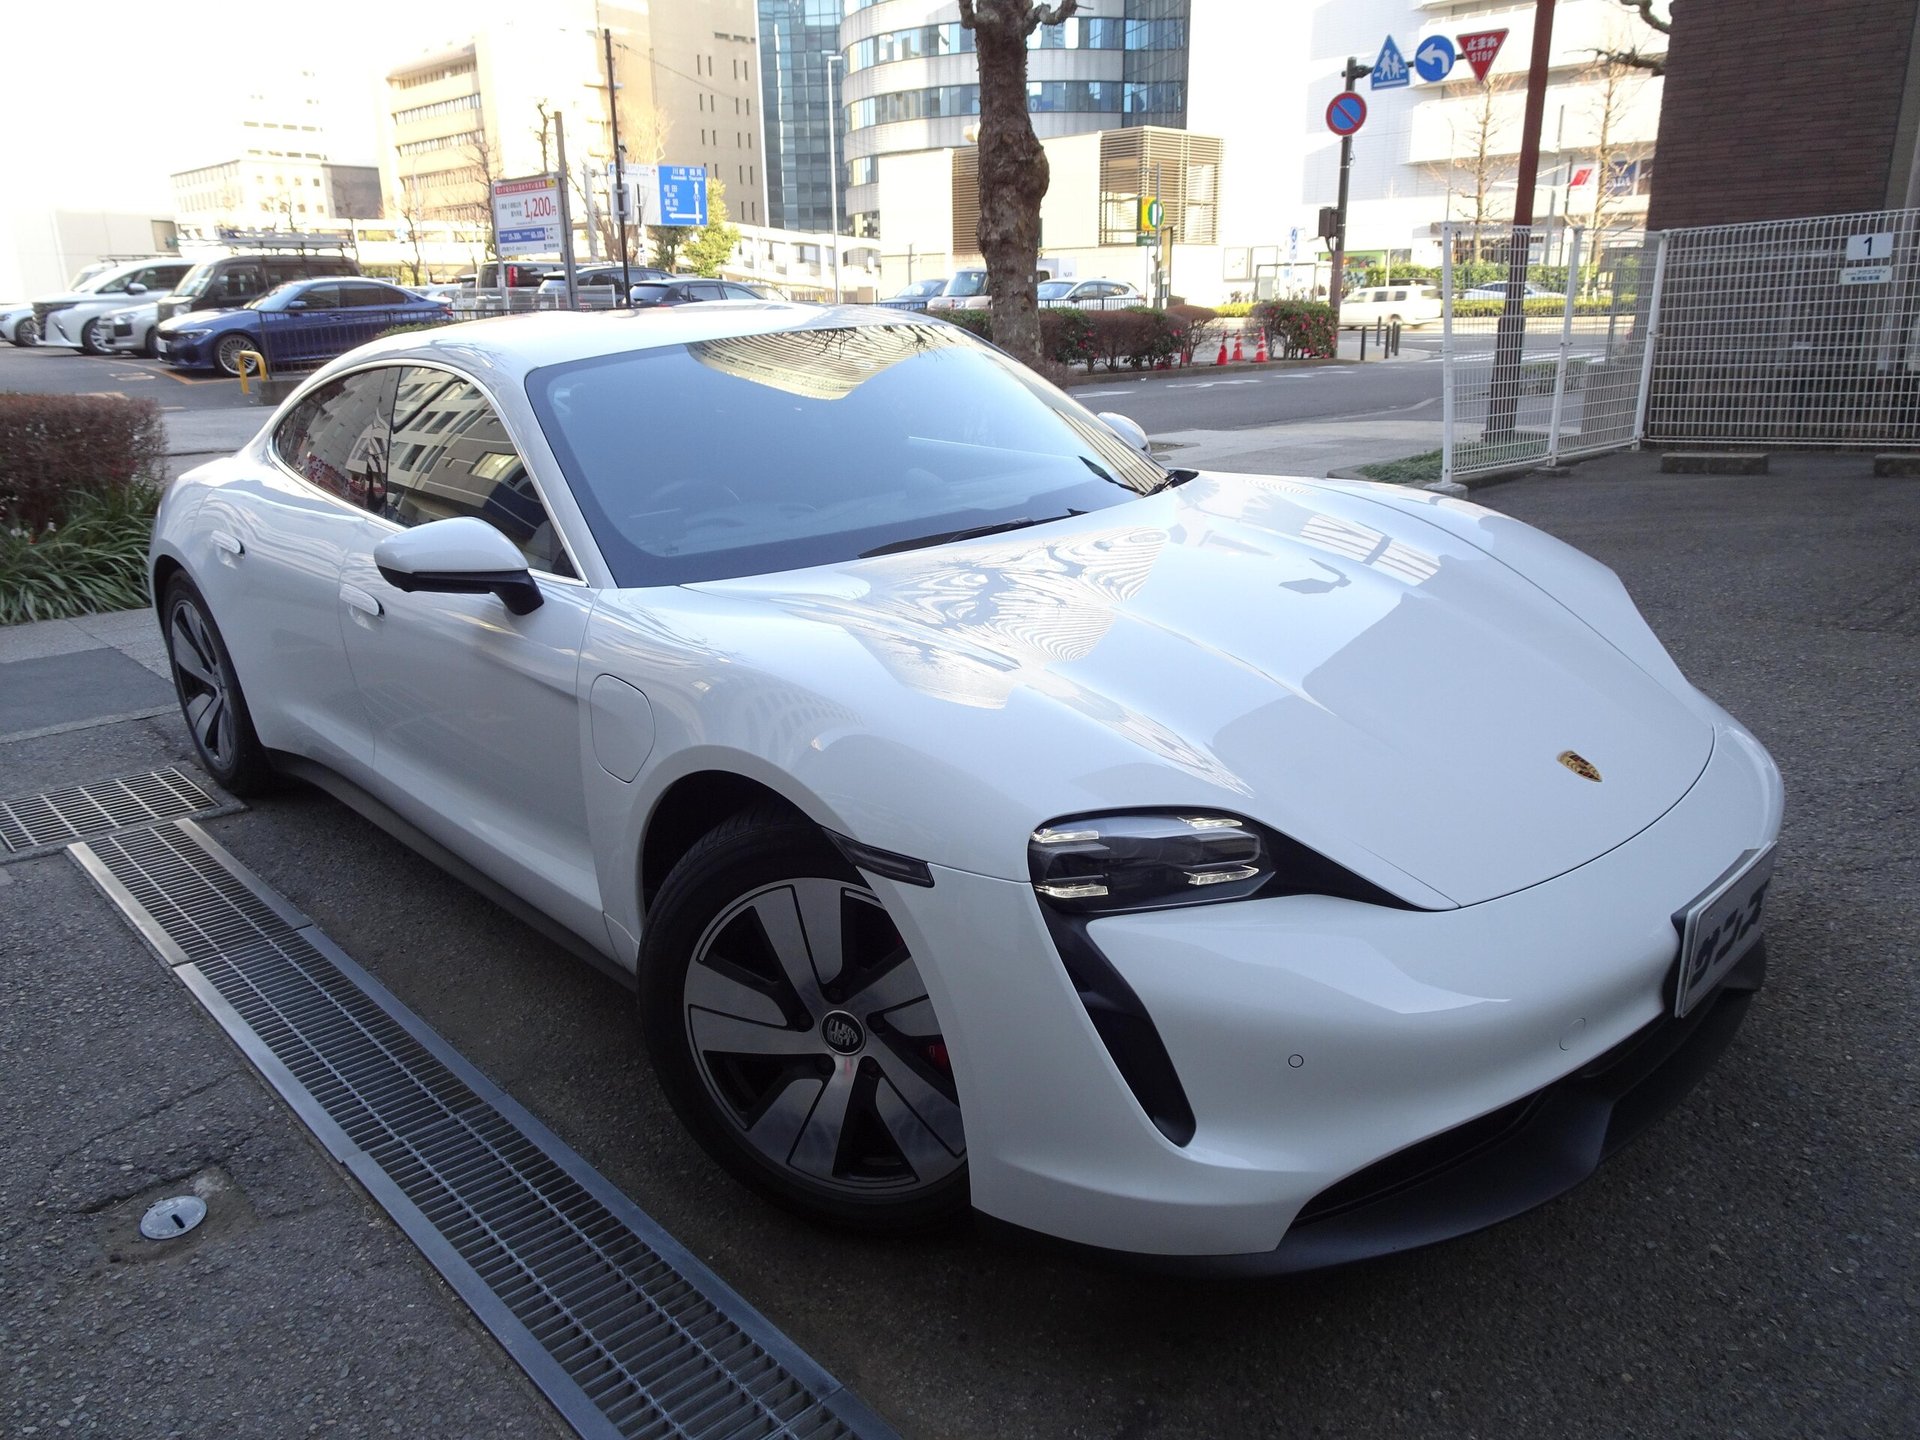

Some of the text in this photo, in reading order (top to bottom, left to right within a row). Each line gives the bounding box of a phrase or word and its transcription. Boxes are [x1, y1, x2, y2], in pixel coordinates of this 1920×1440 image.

[1466, 36, 1498, 51] 止まれ
[1471, 50, 1493, 62] STOP
[524, 196, 557, 221] 1,200円
[1864, 236, 1873, 256] 1
